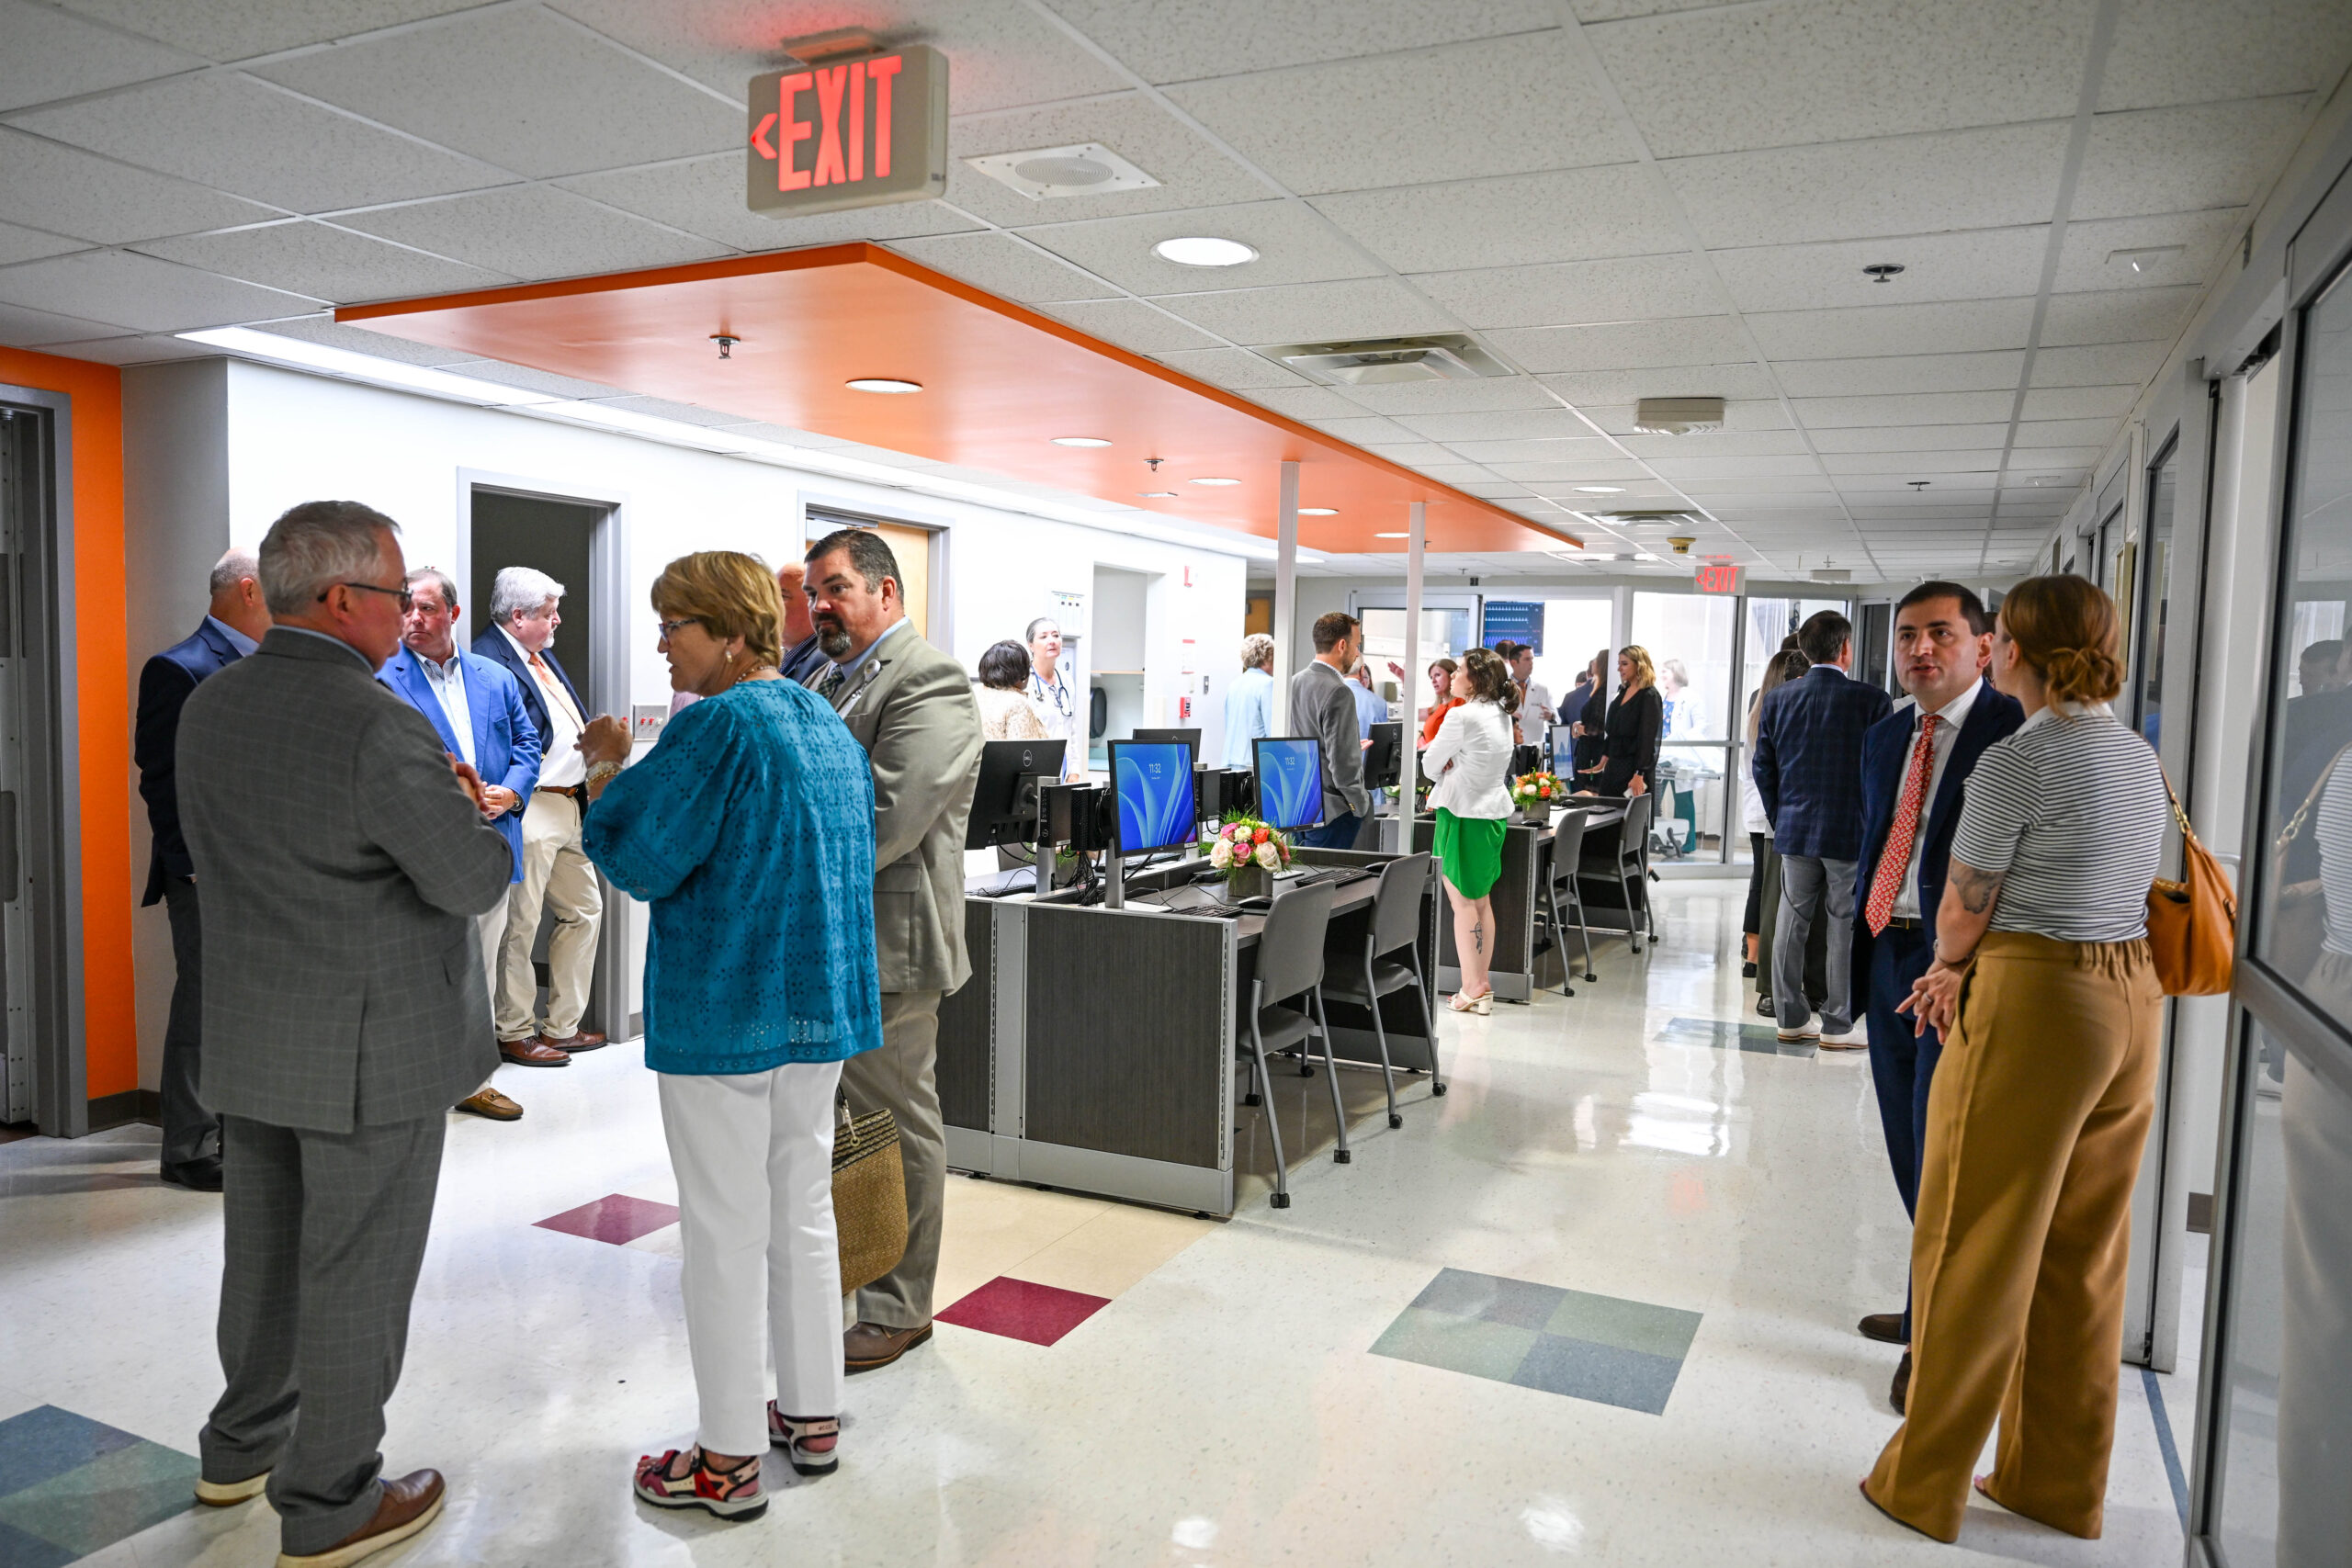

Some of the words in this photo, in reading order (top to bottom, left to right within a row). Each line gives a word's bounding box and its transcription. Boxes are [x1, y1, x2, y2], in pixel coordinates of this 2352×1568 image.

[778, 55, 902, 191] EXIT
[1703, 566, 1738, 592] EXIT
[1149, 762, 1161, 773] 11:32
